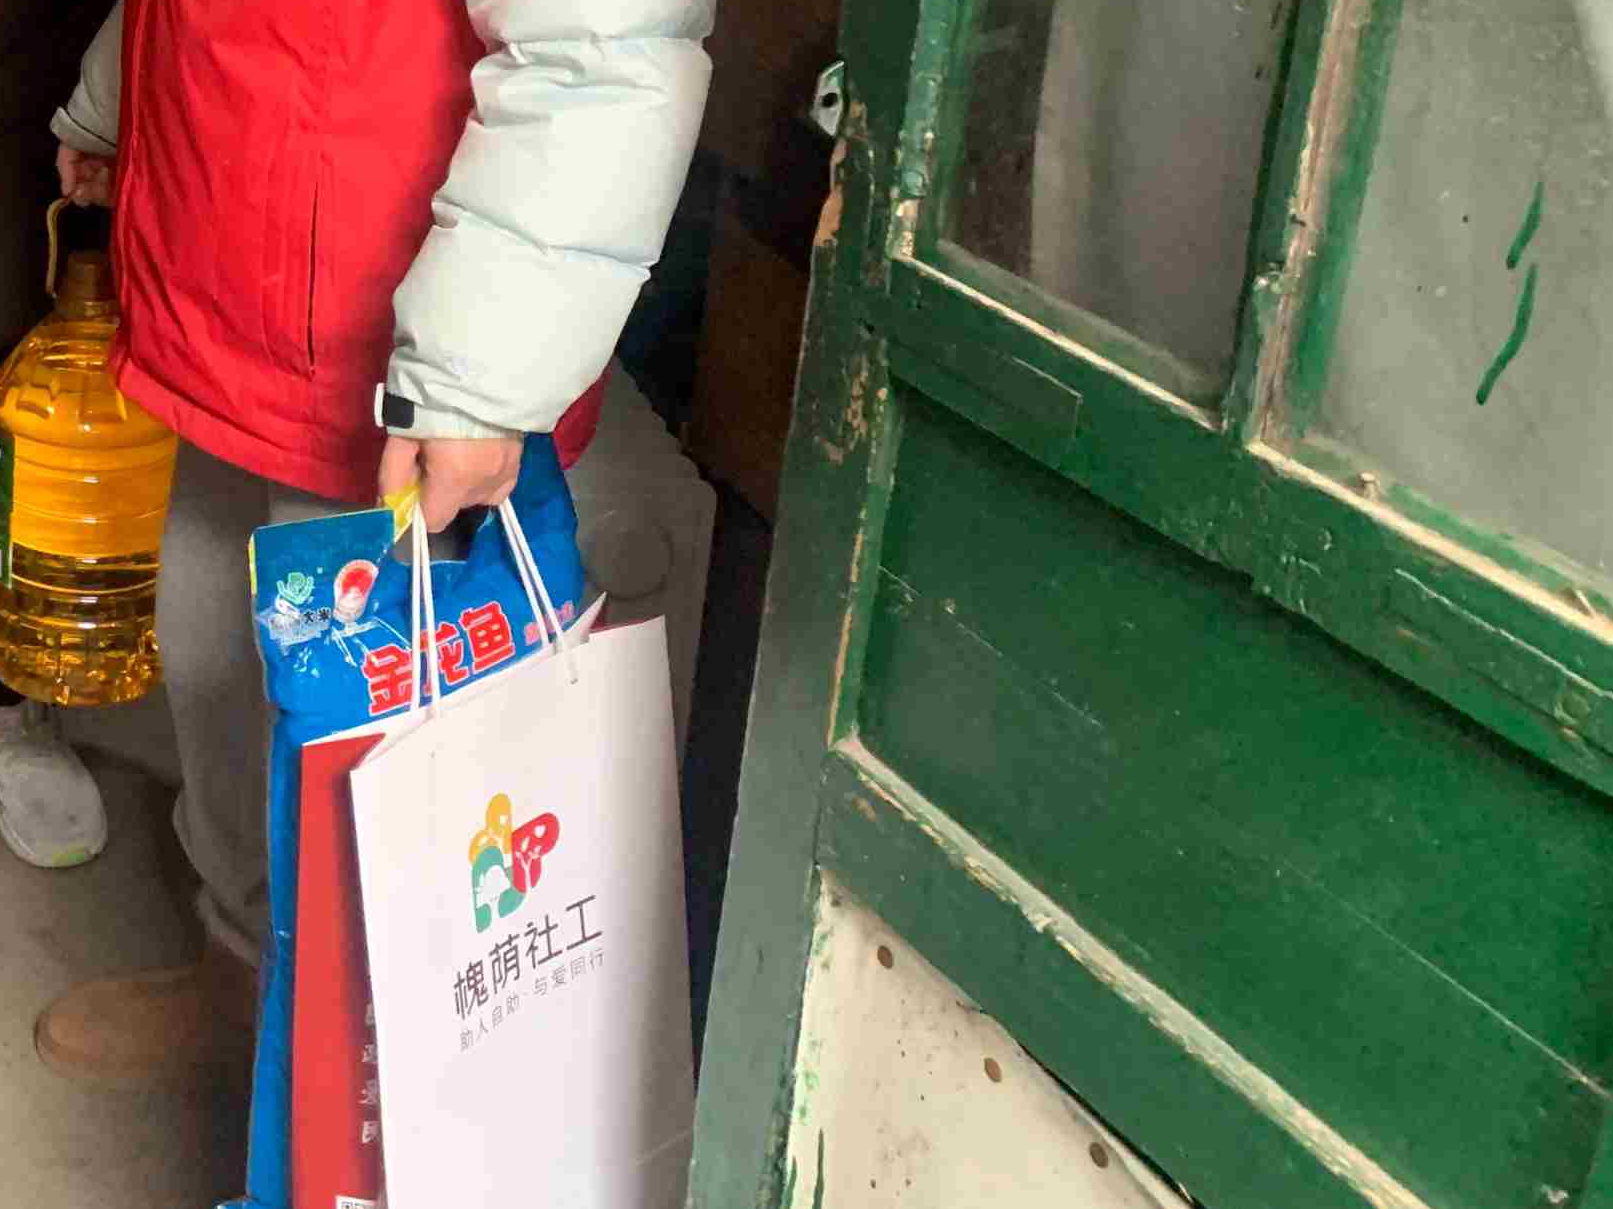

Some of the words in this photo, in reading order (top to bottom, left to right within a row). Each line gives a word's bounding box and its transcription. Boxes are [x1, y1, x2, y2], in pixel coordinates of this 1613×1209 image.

[361, 600, 516, 717] 金龙鱼
[453, 894, 603, 1020] 槐荫社工
